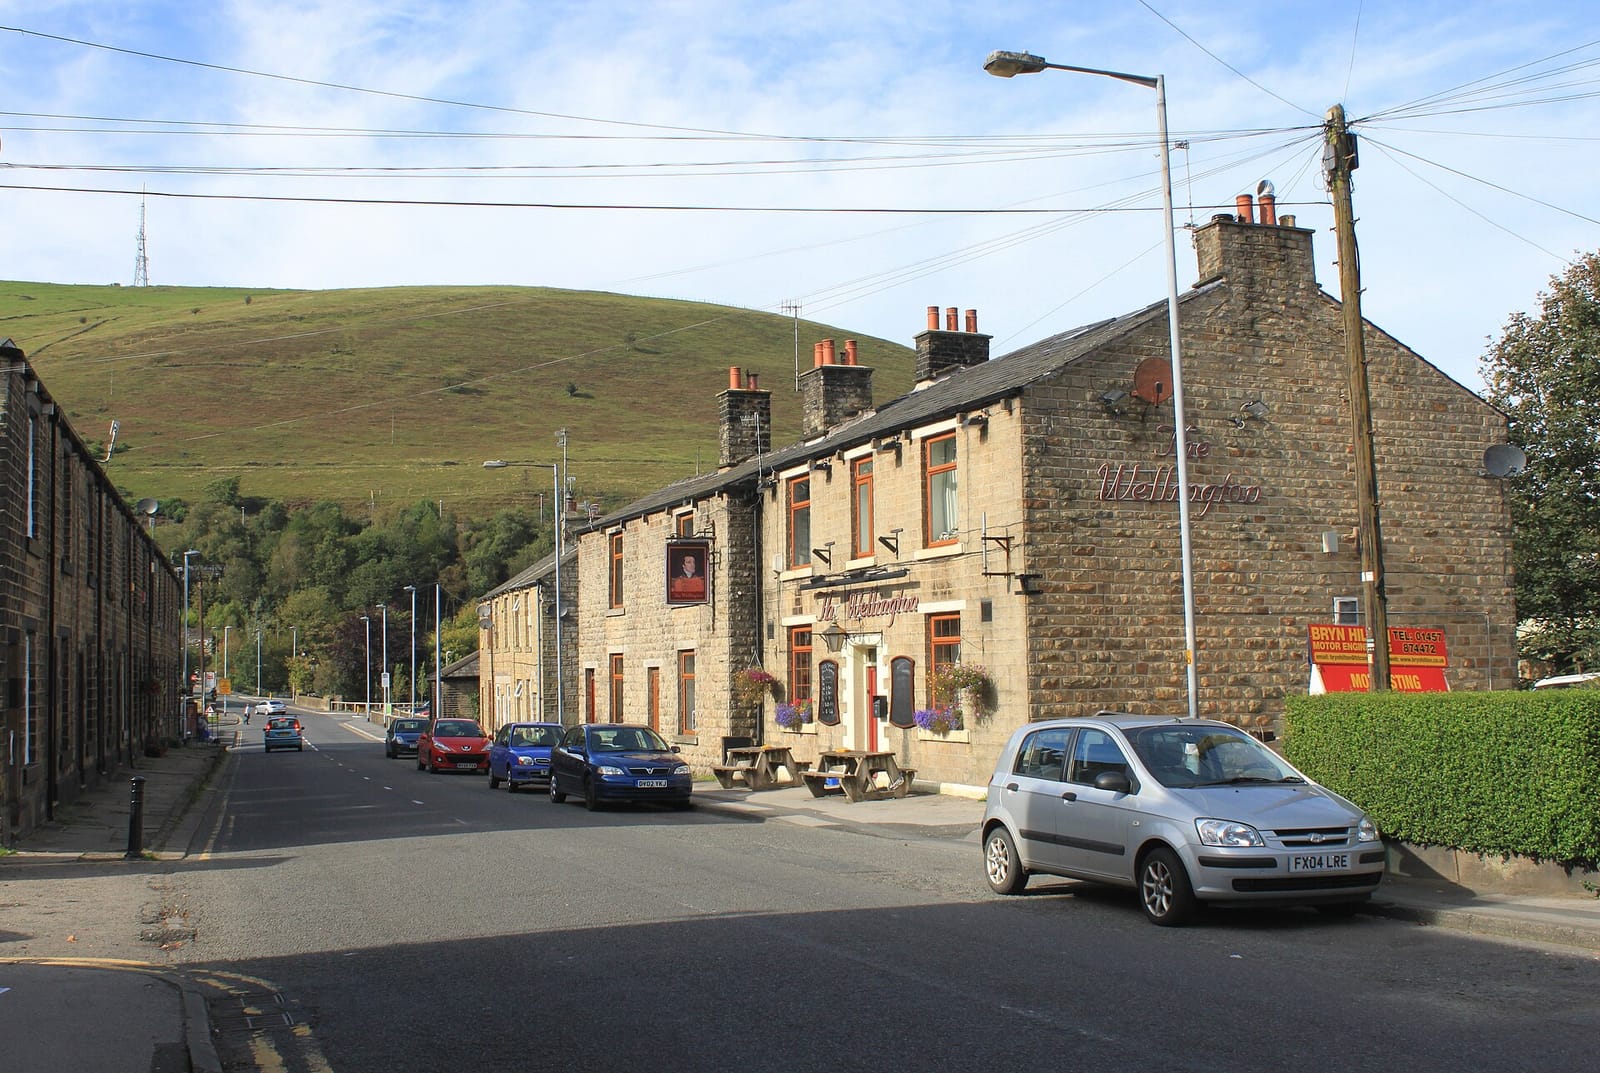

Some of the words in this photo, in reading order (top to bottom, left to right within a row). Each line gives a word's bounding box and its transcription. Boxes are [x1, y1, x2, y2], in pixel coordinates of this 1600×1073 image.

[1097, 462, 1262, 517] Wellington
[815, 590, 839, 621] Th
[847, 590, 919, 628] Wellington
[1311, 626, 1345, 641] BRYN
[1393, 630, 1413, 641] TEL:
[1415, 631, 1442, 643] 01457
[1312, 641, 1341, 651] MOTOR
[1403, 643, 1436, 654] 874472
[1350, 673, 1370, 689] MO
[1294, 856, 1324, 869] FX04
[1326, 855, 1347, 868] LRE
